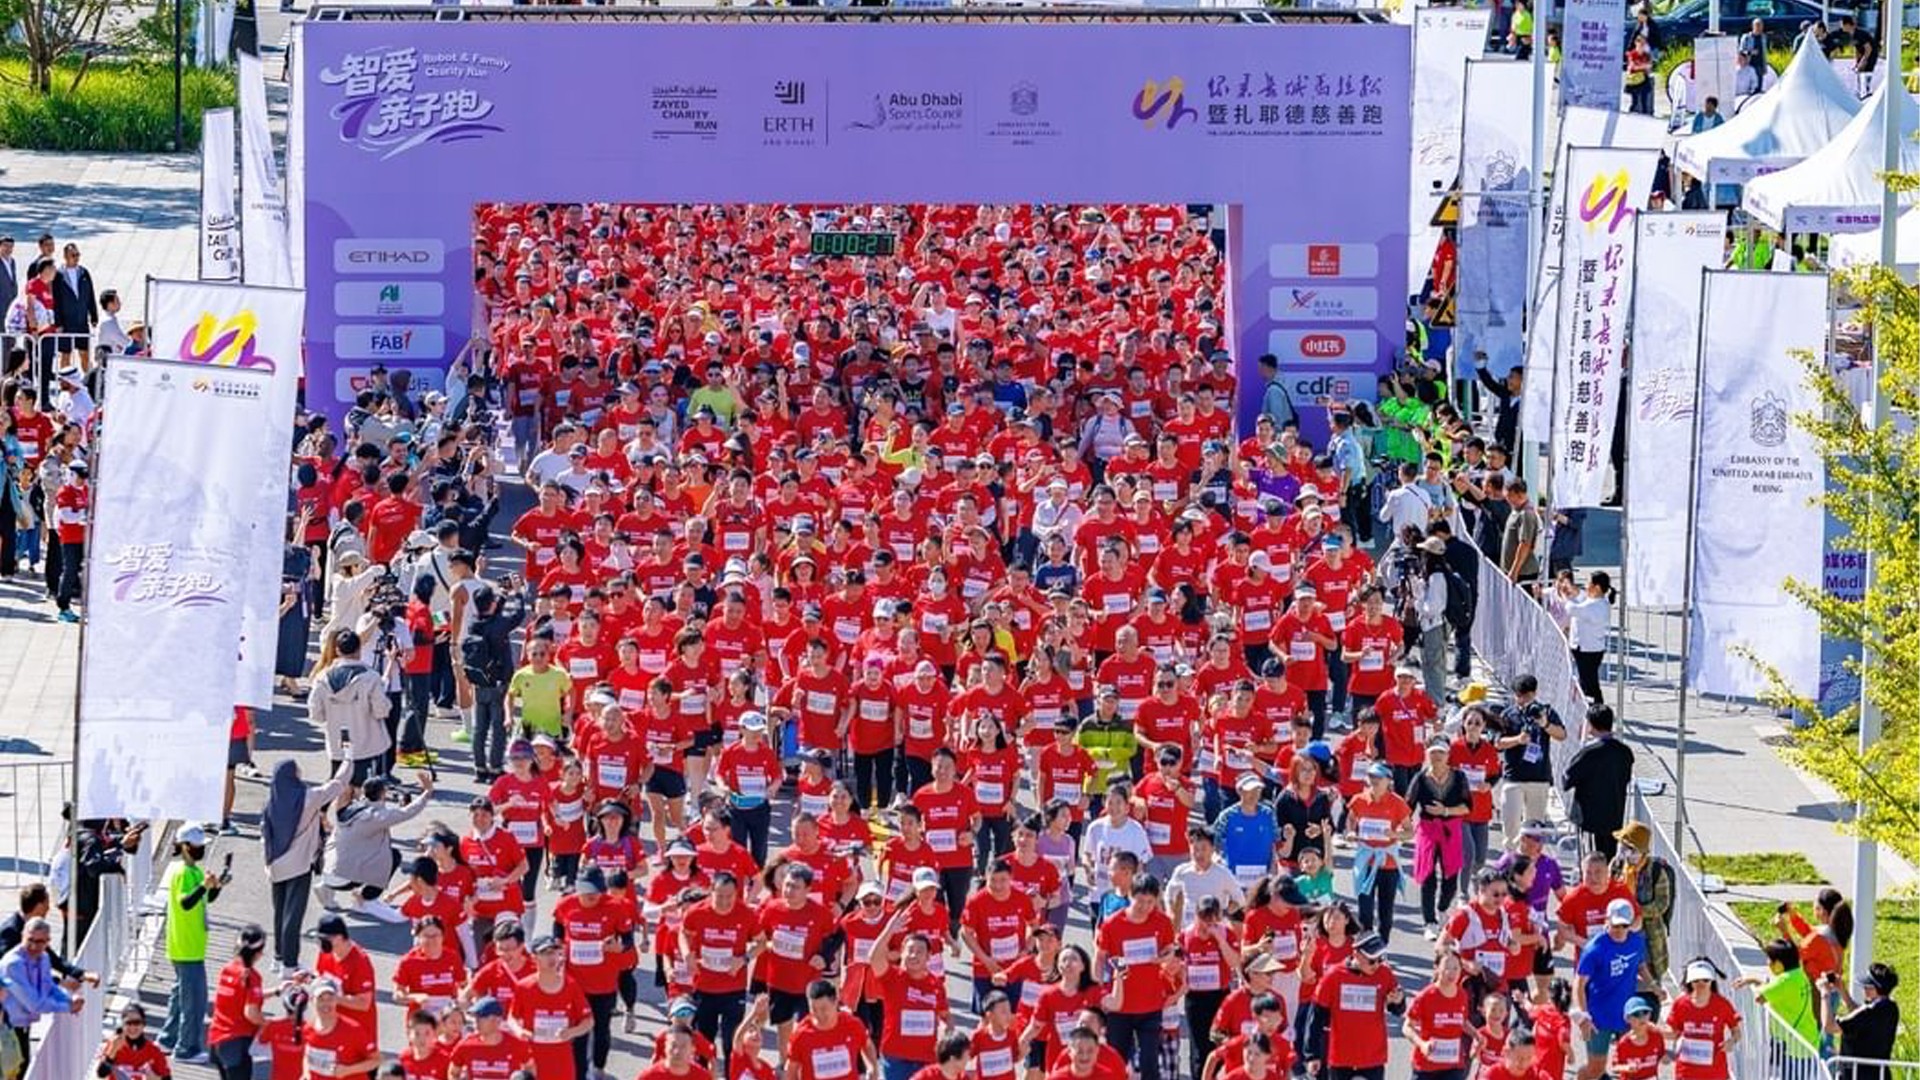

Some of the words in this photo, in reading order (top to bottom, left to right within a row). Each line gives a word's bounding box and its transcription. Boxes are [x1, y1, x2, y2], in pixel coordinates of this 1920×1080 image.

[319, 47, 418, 97] 智爱
[652, 100, 690, 110] ZAYED
[889, 93, 918, 106] Abu
[921, 92, 963, 106] Dhabi
[367, 89, 495, 137] 亲子跑
[662, 110, 709, 120] CHARITY
[889, 108, 919, 120] Sports
[921, 108, 963, 119] Council
[1207, 104, 1383, 125] 暨扎耶德慈善跑
[694, 121, 718, 130] RUN
[763, 117, 814, 132] ERTH
[813, 234, 893, 254] 0:00:27
[348, 250, 430, 263] ETIHAD
[1571, 259, 1597, 462] 暨扎耶德慈善跑
[1730, 455, 1771, 465] EMBASSY
[1774, 457, 1784, 465] OF
[1787, 457, 1799, 466] THE
[1712, 468, 1749, 478] UNITED
[1751, 470, 1775, 479] ARAB
[1826, 575, 1863, 588] Medi
